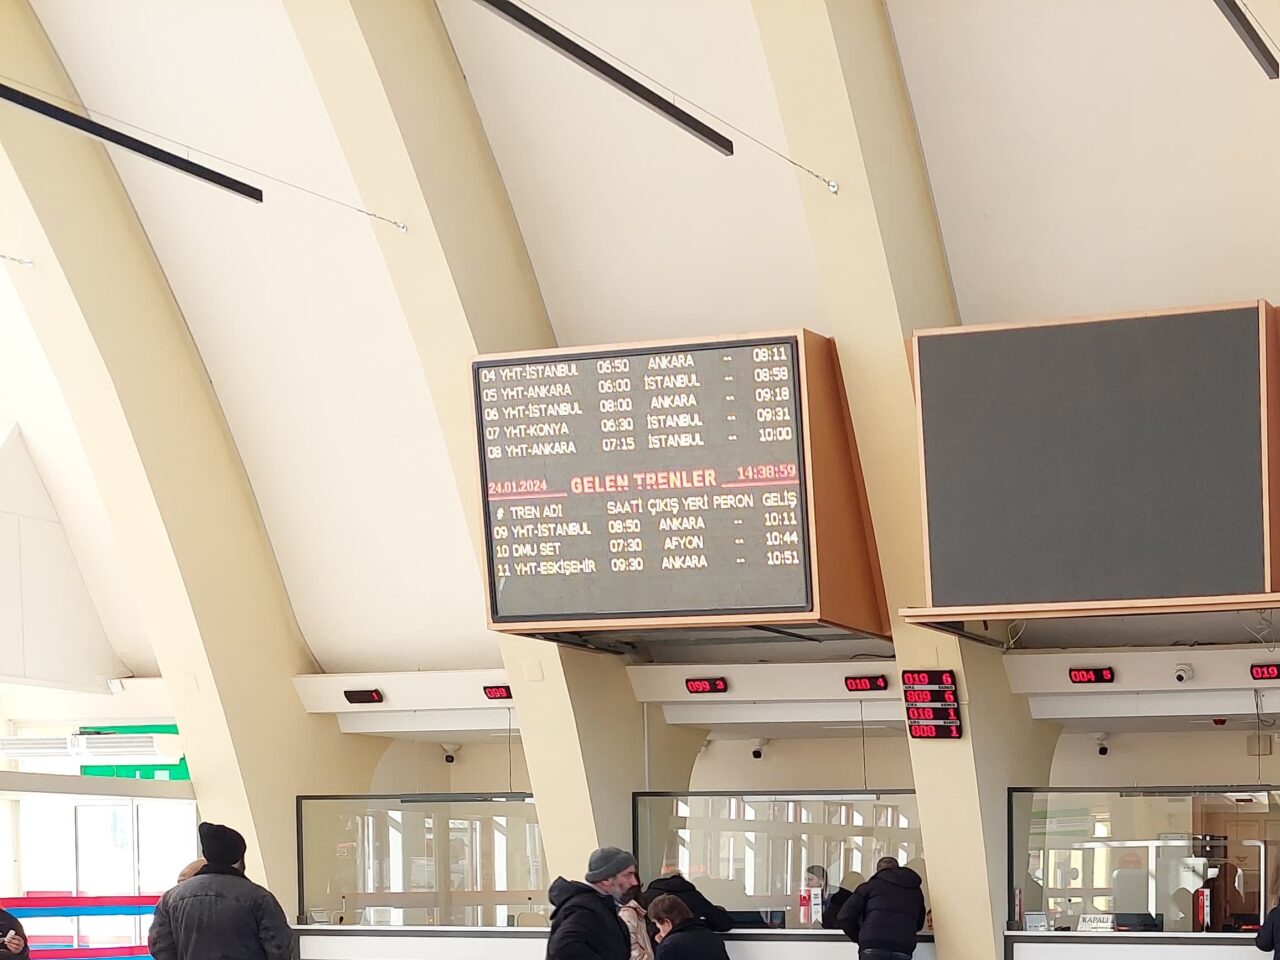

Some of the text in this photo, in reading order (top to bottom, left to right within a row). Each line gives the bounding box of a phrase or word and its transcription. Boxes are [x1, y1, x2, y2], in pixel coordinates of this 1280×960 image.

[482, 347, 786, 382] 04 YHT-İSTANBUL 06:50 ANKARA 08:11
[483, 367, 788, 401] 05 YHT-ANKARA 06:00 İSTANBUL 08:58
[484, 387, 789, 420] 06 YHT-İSTANBUL 08:00 ANKARA 09:18
[486, 407, 790, 439] 07 YHT-KONYA 06:30 İSTANBUL 09:31
[488, 427, 792, 458] 08 YHT-ANKARA 07:15 İSTANBUL 10:00
[488, 464, 796, 494] 24.01.2024 GELEN TRENLER 14:38:59
[510, 506, 540, 519] TREN
[543, 504, 562, 518] ADI
[607, 497, 643, 514] SAATİ
[648, 498, 679, 516] ÇIKIŞ
[682, 494, 708, 511] YERİ
[713, 494, 754, 509] PERON
[762, 488, 797, 508] GELİŞ
[494, 512, 797, 539] 09 YHT-İSTANBUL 08:50 ANKARA 10:11
[496, 531, 798, 558] 10 DMU SET 07:30 AFYON 10:44
[498, 551, 799, 576] 11 YHT-ESKİŞEHİR 09:30 ANKARA 10:51
[904, 673, 952, 685] 019 6
[1071, 670, 1111, 682] 004 5
[1253, 667, 1278, 678] 019
[485, 688, 507, 698] 099
[687, 680, 725, 691] 099 3
[847, 678, 885, 690] 010 4
[906, 691, 954, 702] 809 6
[909, 708, 956, 719] 018 1
[950, 726, 959, 736] 1
[1082, 916, 1109, 924] KAPALI
